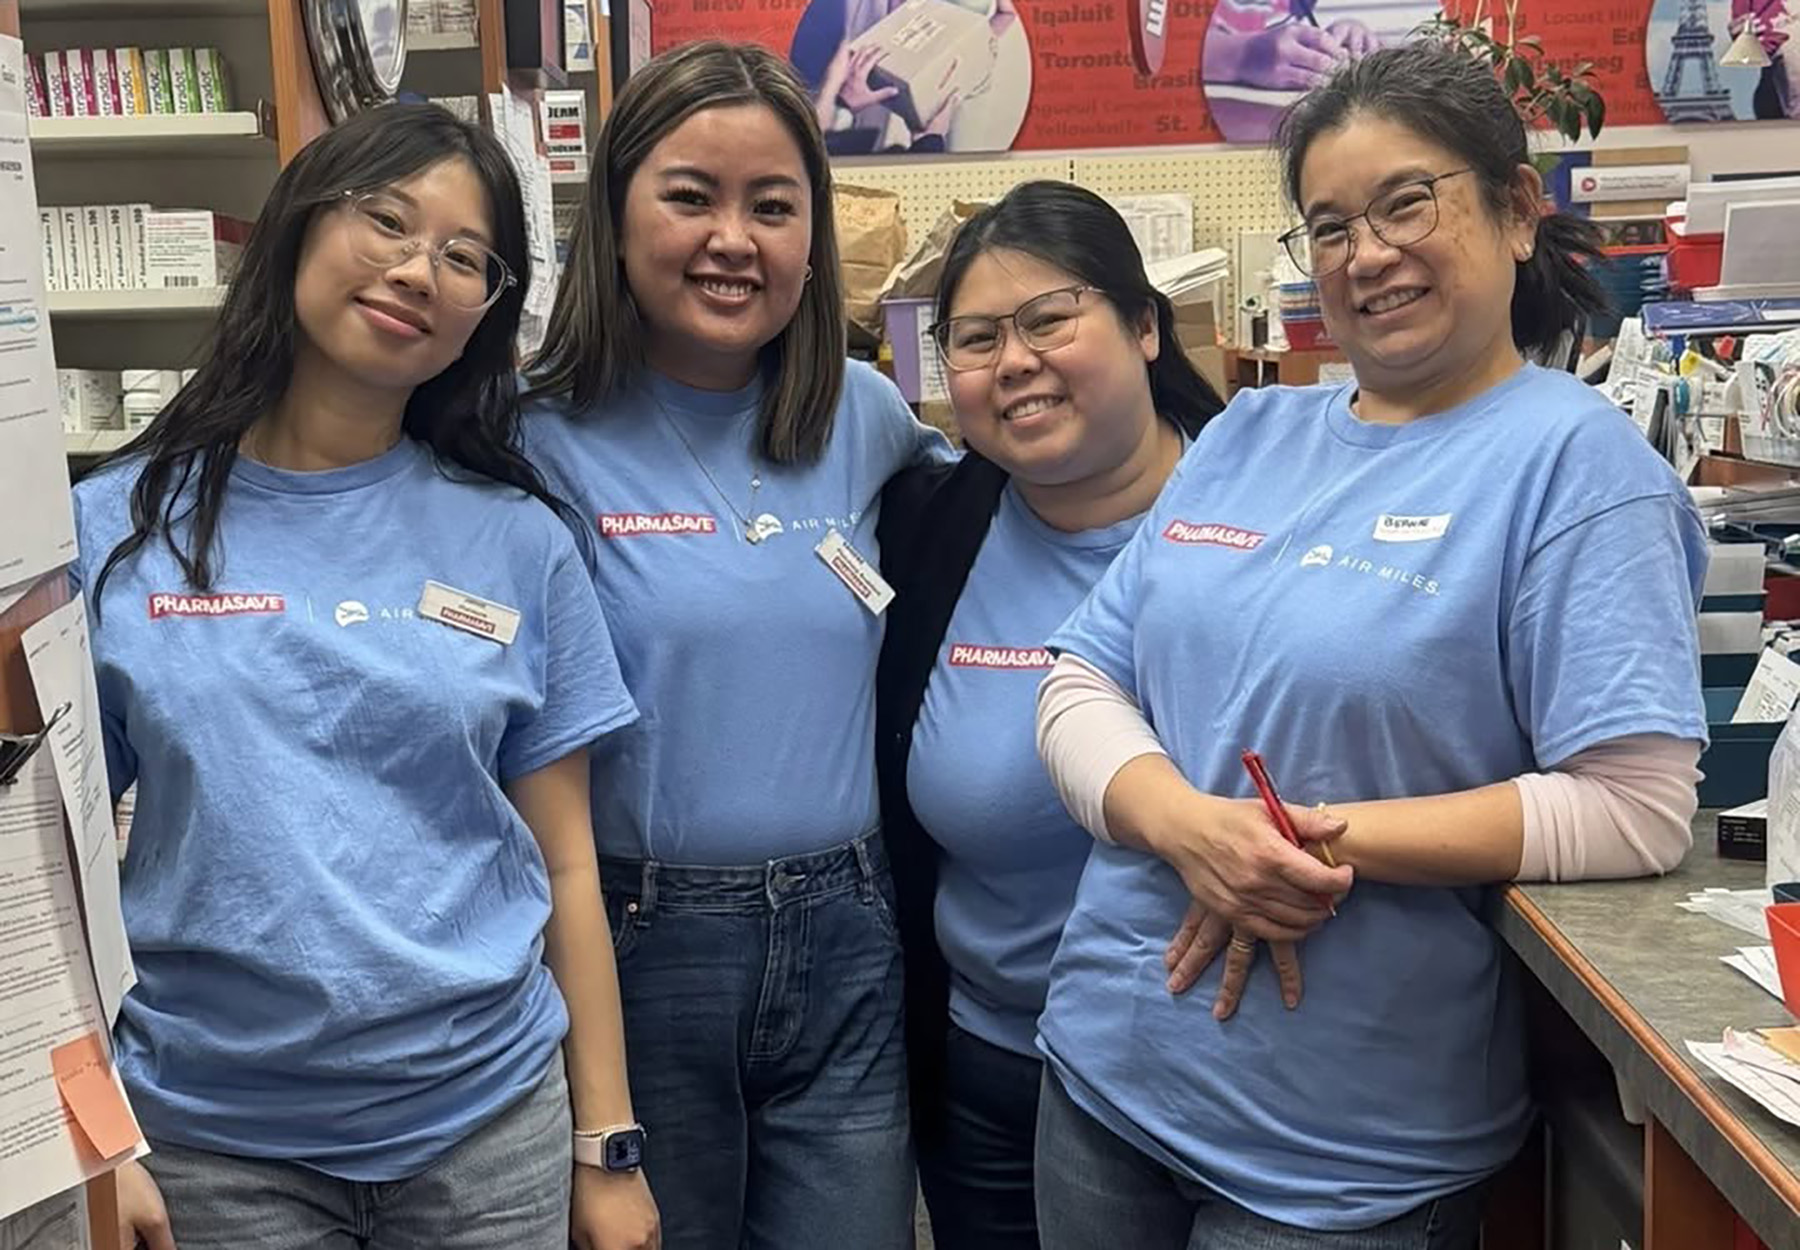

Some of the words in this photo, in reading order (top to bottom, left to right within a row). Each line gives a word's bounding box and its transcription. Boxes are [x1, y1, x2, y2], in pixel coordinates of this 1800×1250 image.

[1033, 5, 1115, 27] Iqaluit
[601, 515, 714, 534] PHARMASAVE
[792, 519, 820, 531] AIR
[824, 512, 861, 529] MILE
[1168, 522, 1264, 548] PHARMASAVE
[1338, 555, 1373, 574] AIR
[152, 594, 284, 615] PHARMASAVE
[380, 607, 415, 620] AIR
